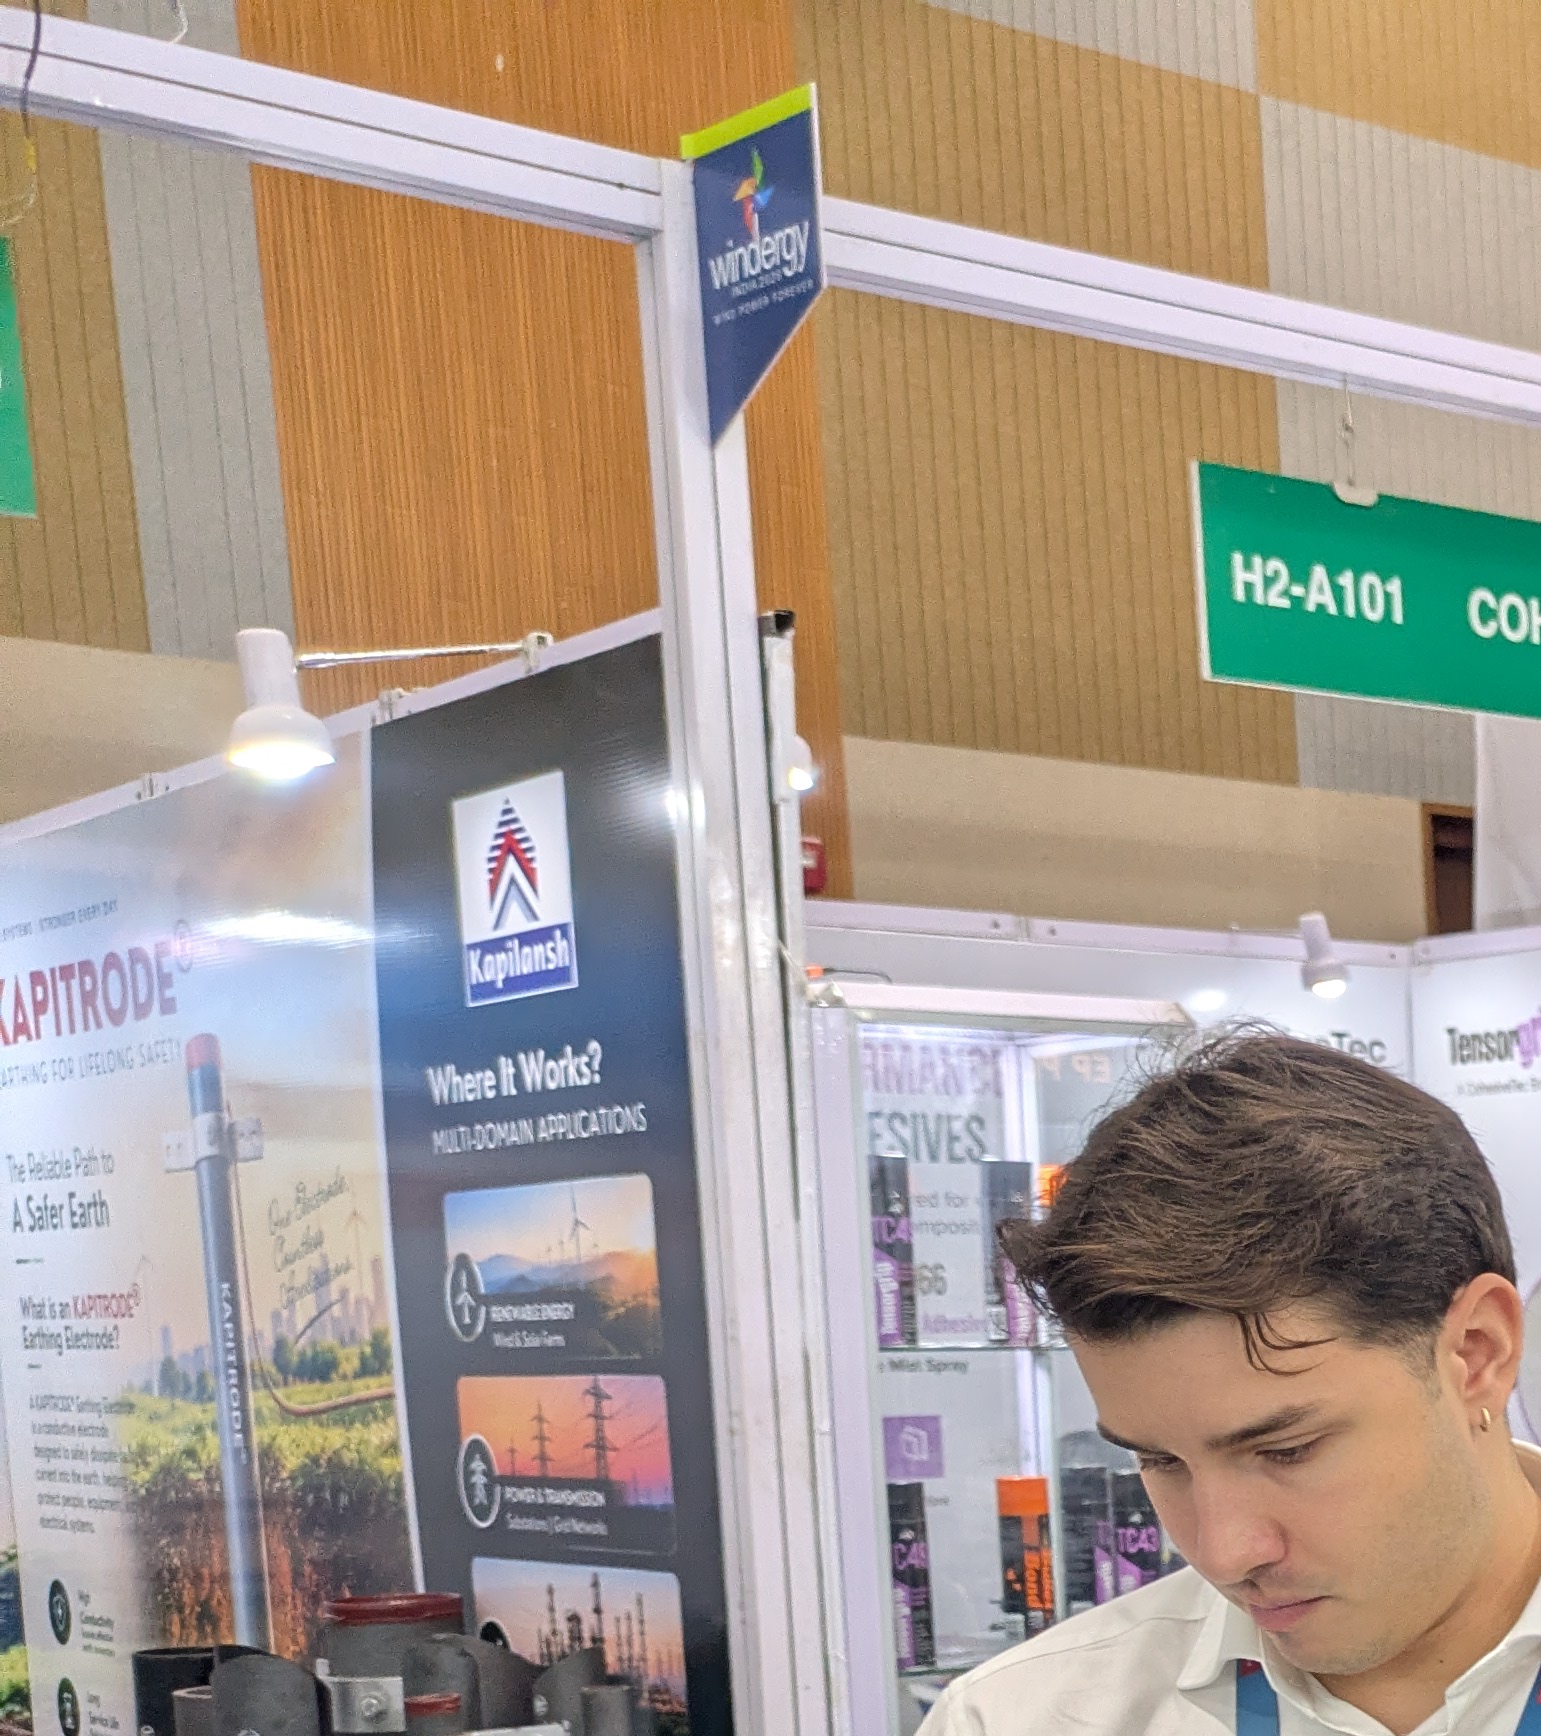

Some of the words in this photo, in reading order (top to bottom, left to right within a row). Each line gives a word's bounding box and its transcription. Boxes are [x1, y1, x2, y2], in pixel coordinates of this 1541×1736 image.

[708, 220, 810, 290] windergy
[1231, 553, 1405, 625] H2-A101
[467, 928, 570, 989] Kapilansh
[426, 1063, 497, 1107] Where
[498, 1054, 517, 1097] It
[517, 1039, 603, 1094] Works?
[431, 1117, 535, 1155] MULTI-DOMAIN
[536, 1101, 648, 1143] APPLICATIONS
[13, 1196, 24, 1234] A
[27, 1193, 64, 1231] Safer
[68, 1190, 111, 1229] Earth
